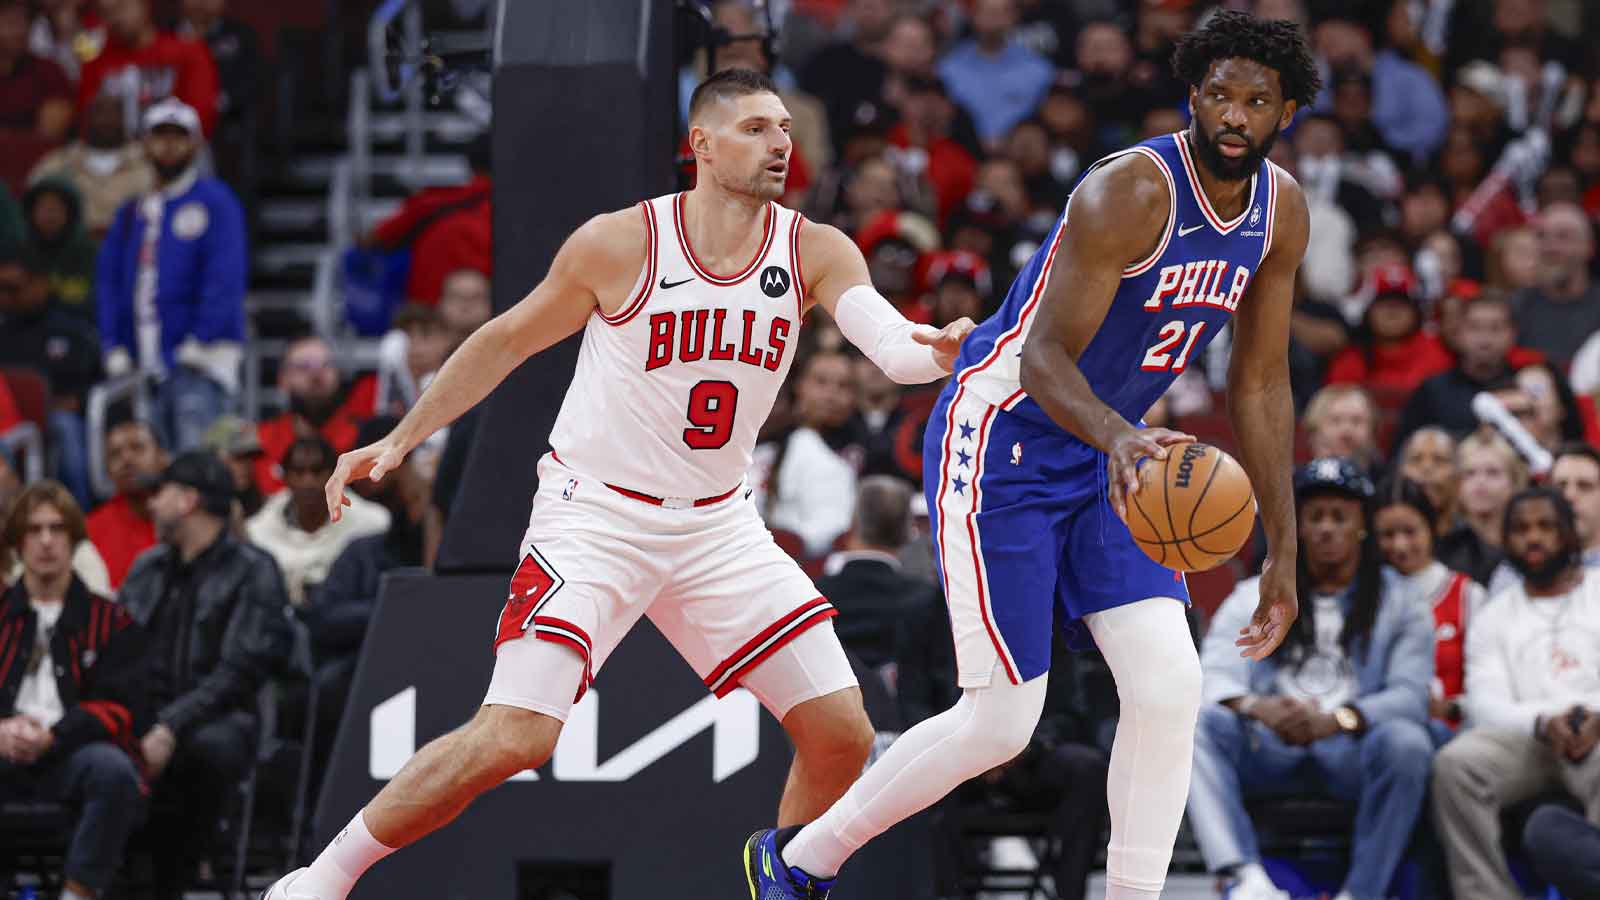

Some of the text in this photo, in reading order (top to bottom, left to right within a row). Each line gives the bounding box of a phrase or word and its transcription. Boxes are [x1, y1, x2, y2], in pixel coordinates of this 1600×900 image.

[1143, 259, 1250, 313] PHILA
[645, 308, 791, 372] BULLS
[1140, 320, 1207, 374] 21
[682, 380, 739, 450] 9
